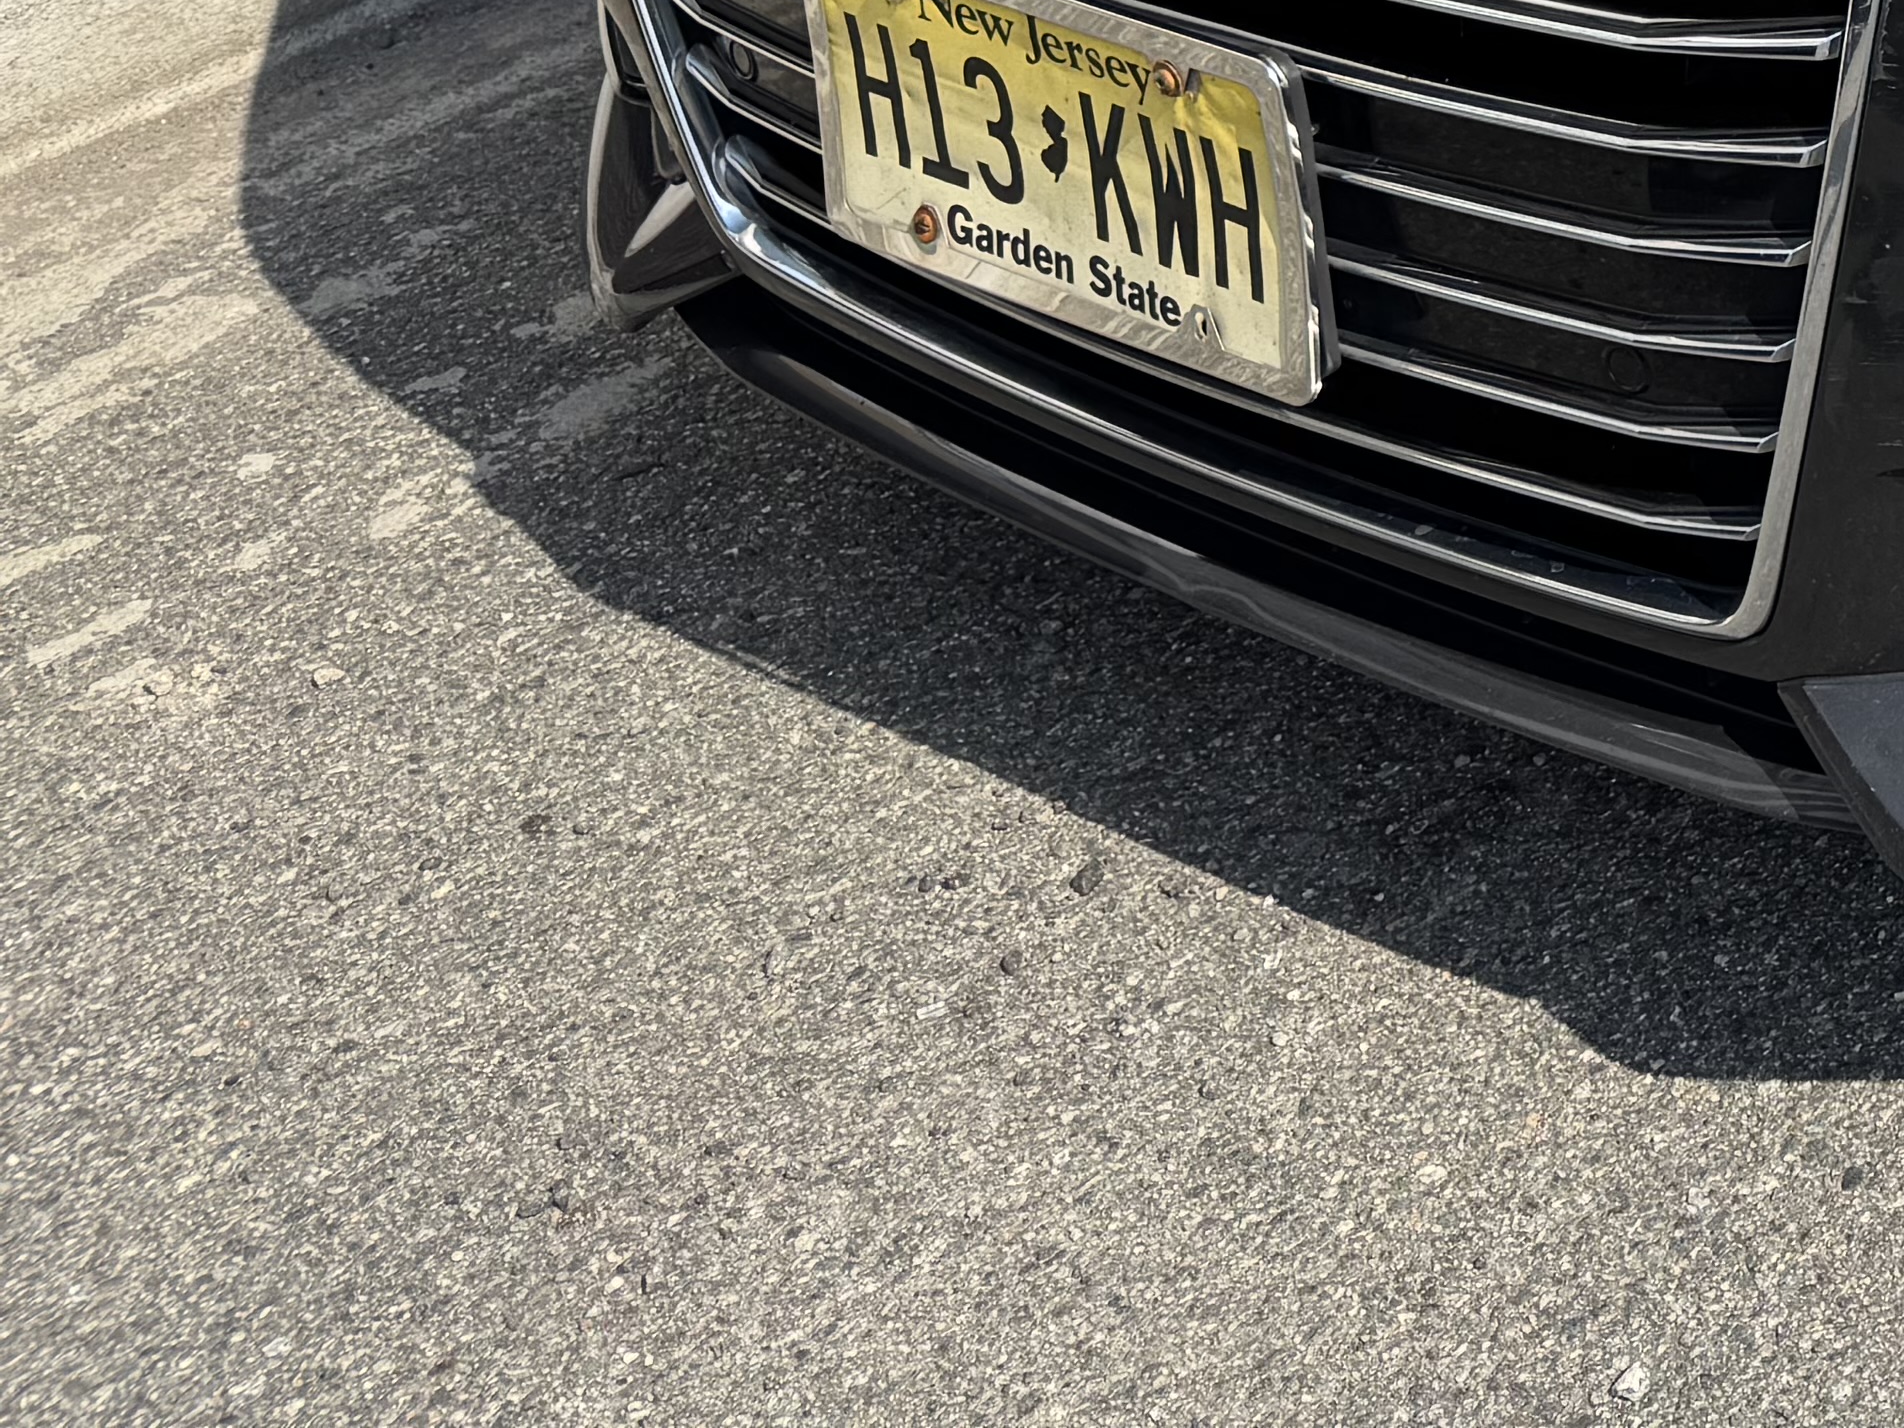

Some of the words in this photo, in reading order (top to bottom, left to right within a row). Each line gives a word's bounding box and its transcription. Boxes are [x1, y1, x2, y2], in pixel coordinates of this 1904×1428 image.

[1024, 13, 1151, 105] Jersey
[843, 10, 1025, 205] H13
[1078, 90, 1265, 305] KWH
[946, 203, 1075, 285] Garden
[1088, 254, 1182, 328] State
